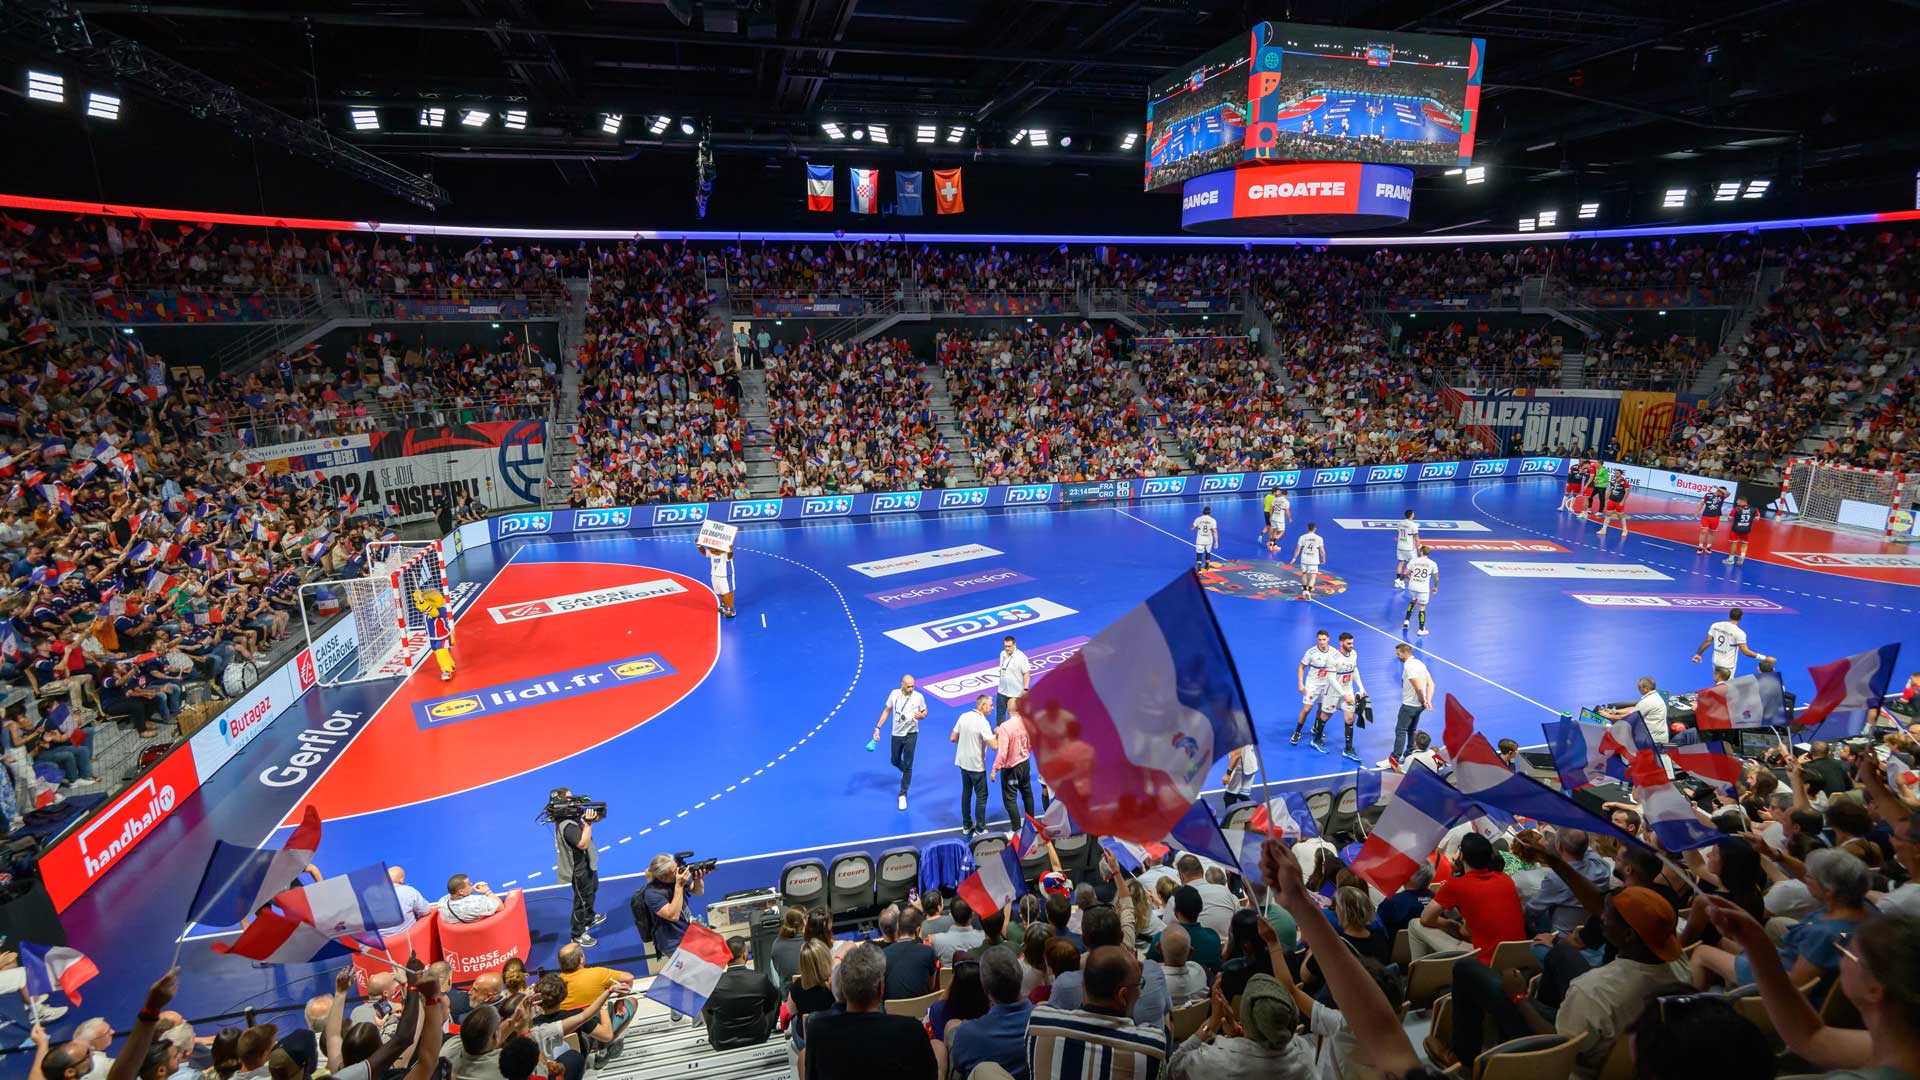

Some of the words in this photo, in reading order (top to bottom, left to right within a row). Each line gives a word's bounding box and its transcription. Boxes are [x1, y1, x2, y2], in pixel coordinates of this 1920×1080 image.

[1248, 181, 1346, 200] CROATIE
[1376, 183, 1412, 201] FRANC
[1182, 189, 1219, 211] RANCE
[1527, 402, 1550, 416] LES
[1422, 465, 1445, 477] FDJ
[1473, 462, 1496, 474] FDJ
[1520, 460, 1542, 472] FDJ
[1260, 475, 1284, 486] FDJ
[1315, 472, 1339, 483] FDJ
[1370, 468, 1392, 480] FDJ
[1145, 481, 1169, 493] FDJ
[1203, 478, 1228, 489] FDJ
[1676, 478, 1713, 493] Butagaz
[943, 492, 969, 505] FDJ
[1008, 489, 1034, 501] FDJ
[805, 499, 833, 513] FDJ
[875, 496, 901, 509] FDJ
[657, 508, 687, 522] FDJ
[732, 503, 762, 517] FDJ
[501, 517, 529, 534] FDJ
[578, 512, 609, 527] FDJ
[1202, 524, 1209, 534] 8
[1413, 567, 1428, 579] 28
[556, 589, 631, 606] CAISSE
[560, 586, 679, 612] D'EPARGNE
[931, 613, 999, 640] FDJ
[315, 634, 340, 662] CAISSE
[1716, 634, 1726, 648] 9
[490, 671, 604, 706] lidl.fr
[229, 695, 273, 739] Butagaz
[84, 794, 162, 879] handball
[161, 790, 173, 806] TV
[461, 949, 501, 965] CAISSE
[463, 946, 519, 973] D'EPARGNE
